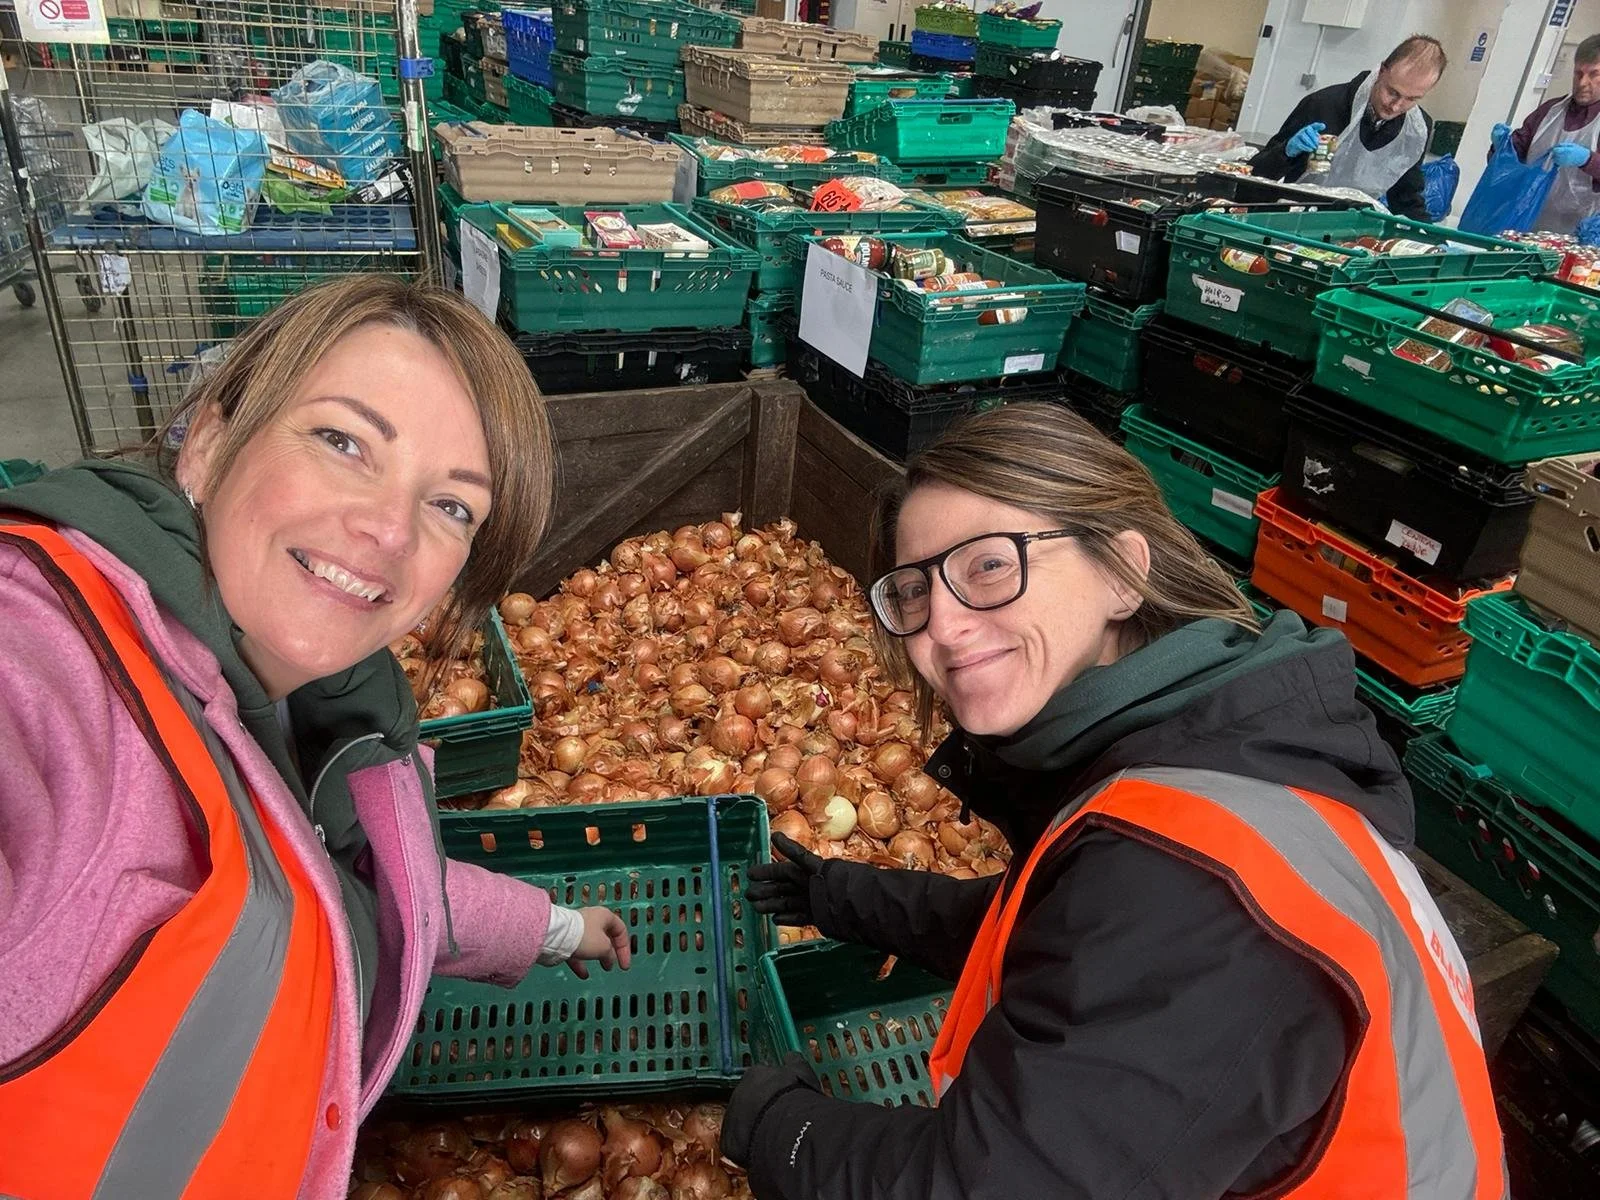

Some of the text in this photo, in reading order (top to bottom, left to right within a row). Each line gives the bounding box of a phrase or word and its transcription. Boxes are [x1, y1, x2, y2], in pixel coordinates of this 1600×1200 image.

[859, 242, 871, 267] DOLM
[820, 268, 853, 293] PASTA SAUCE
